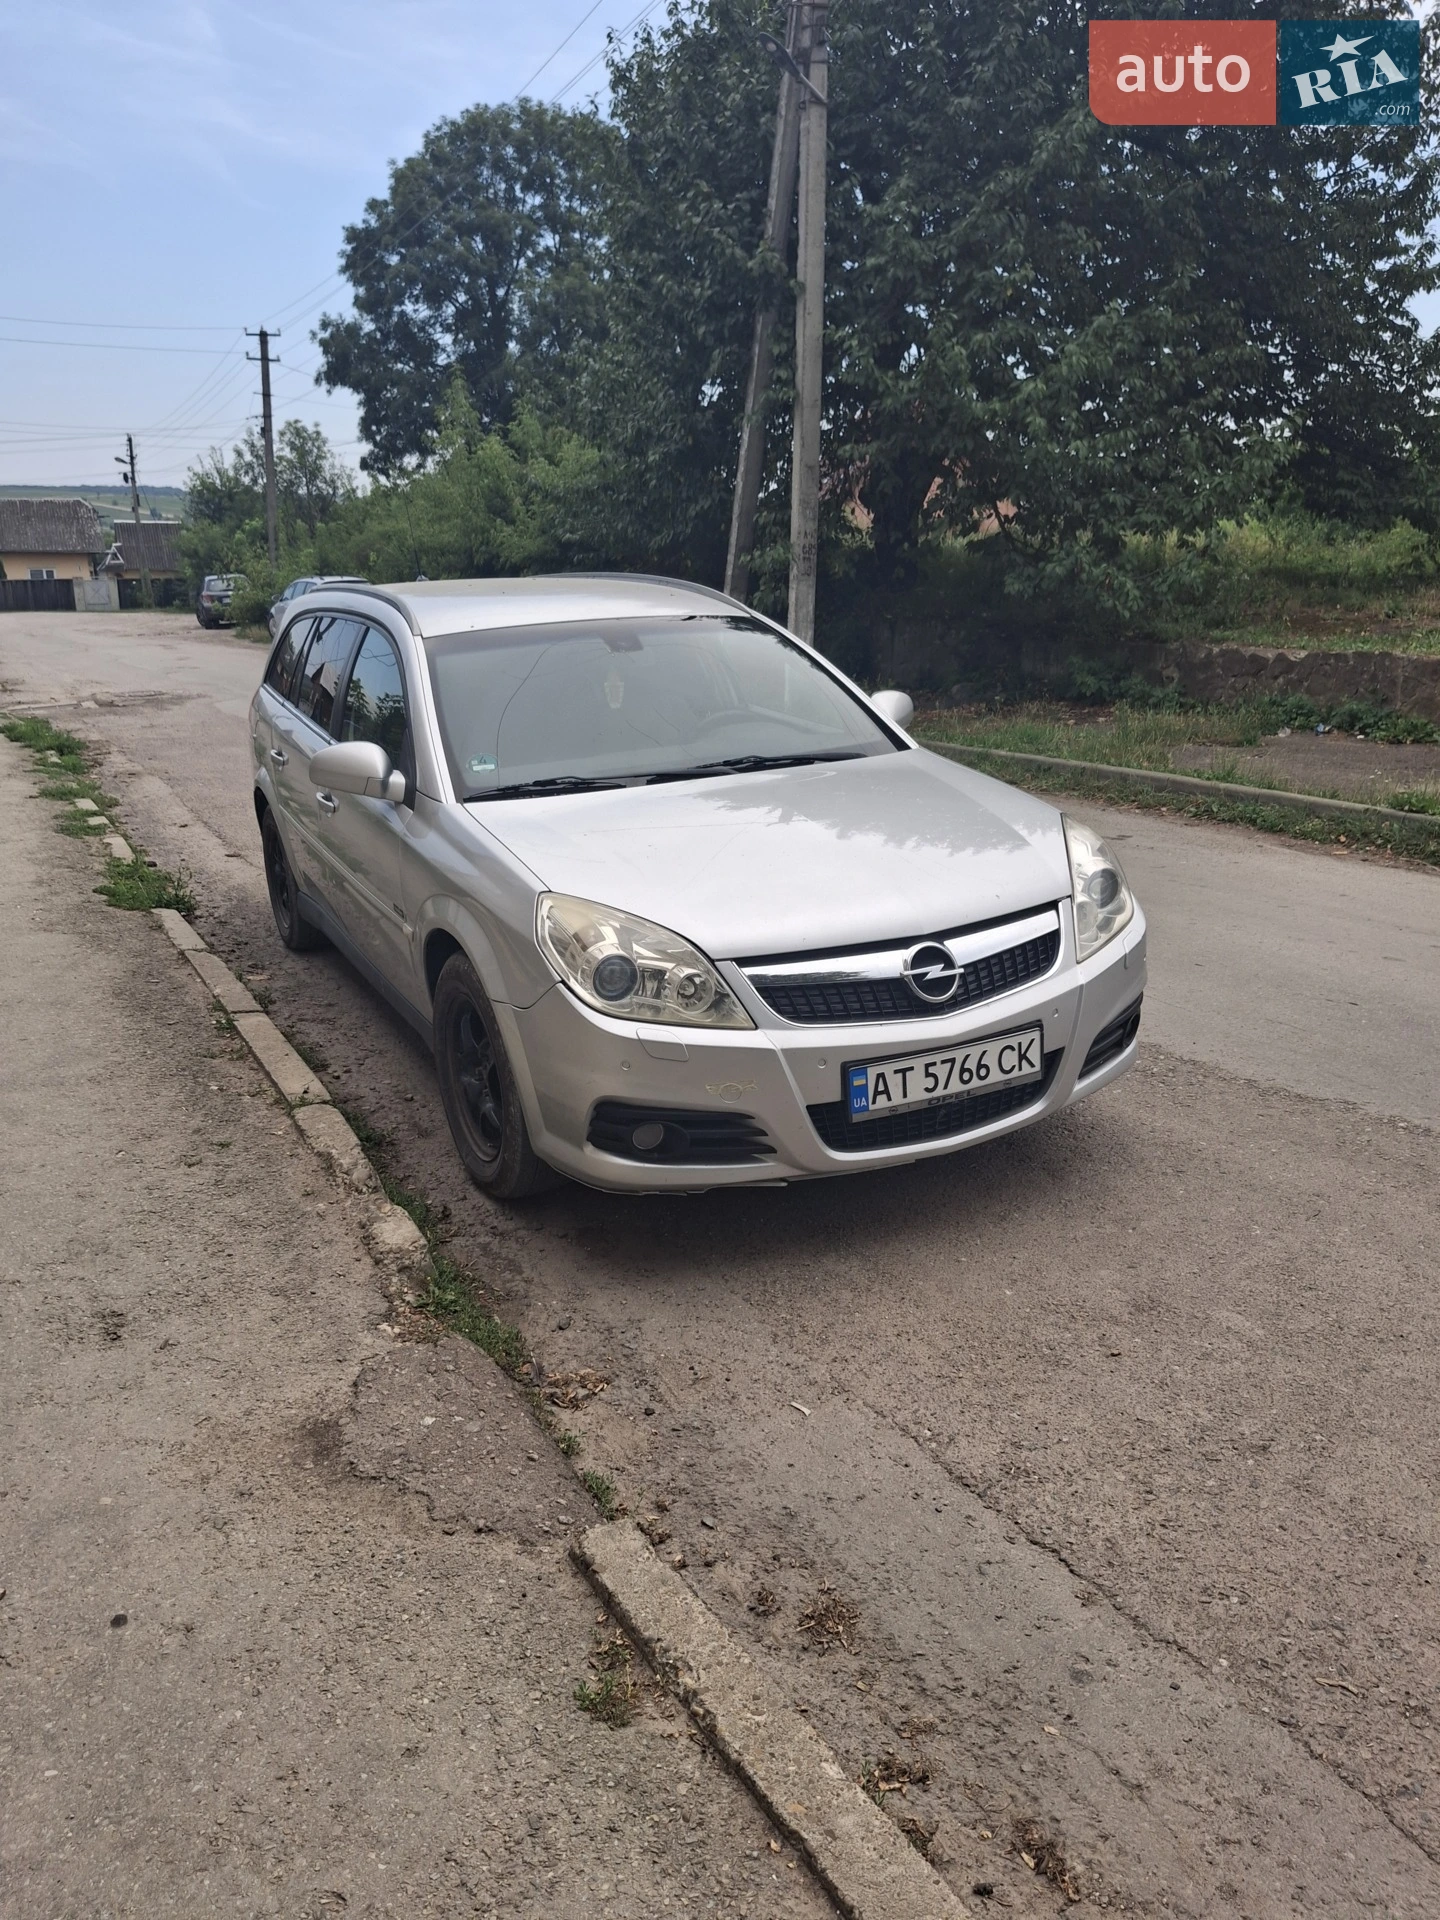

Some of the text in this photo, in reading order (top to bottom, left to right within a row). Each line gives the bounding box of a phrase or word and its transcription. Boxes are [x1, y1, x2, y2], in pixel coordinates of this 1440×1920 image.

[871, 1038, 1036, 1106] AT 5766 CK
[853, 1096, 867, 1108] UA
